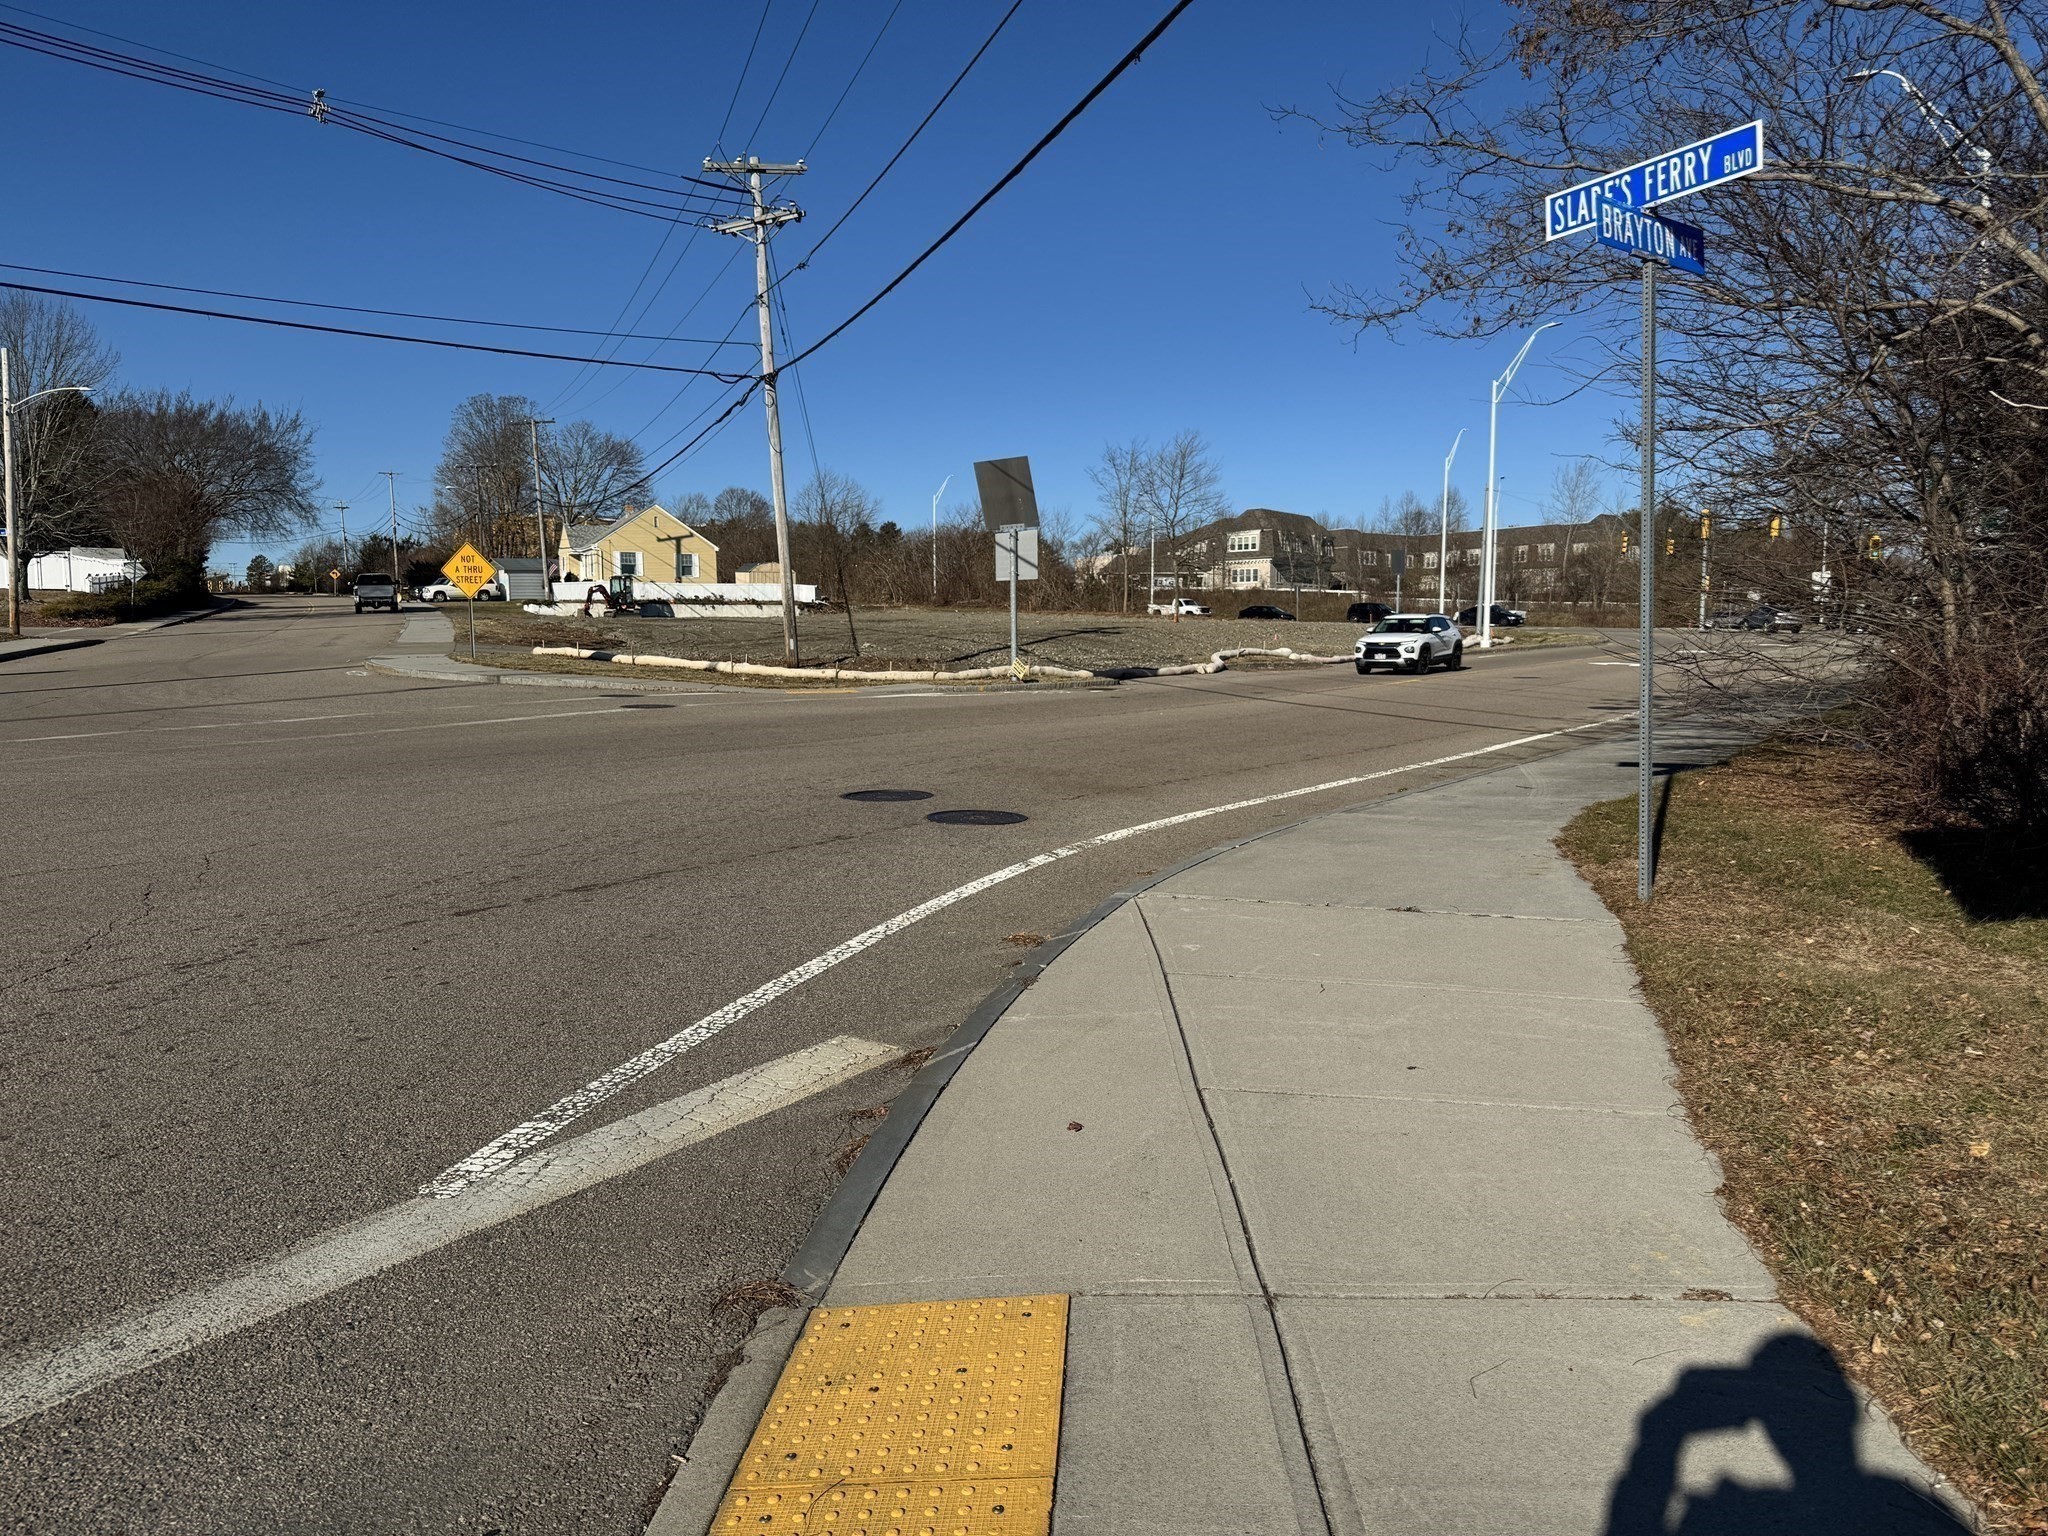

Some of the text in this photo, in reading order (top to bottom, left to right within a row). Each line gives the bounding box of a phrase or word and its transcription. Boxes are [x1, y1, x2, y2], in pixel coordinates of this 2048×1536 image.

[1644, 144, 1712, 201] FERRY
[1723, 147, 1753, 174] BLVD
[1602, 203, 1699, 261] BRAYTON AVE
[460, 555, 476, 564] NOT
[455, 565, 483, 574] A THRU
[456, 575, 483, 584] STREET
